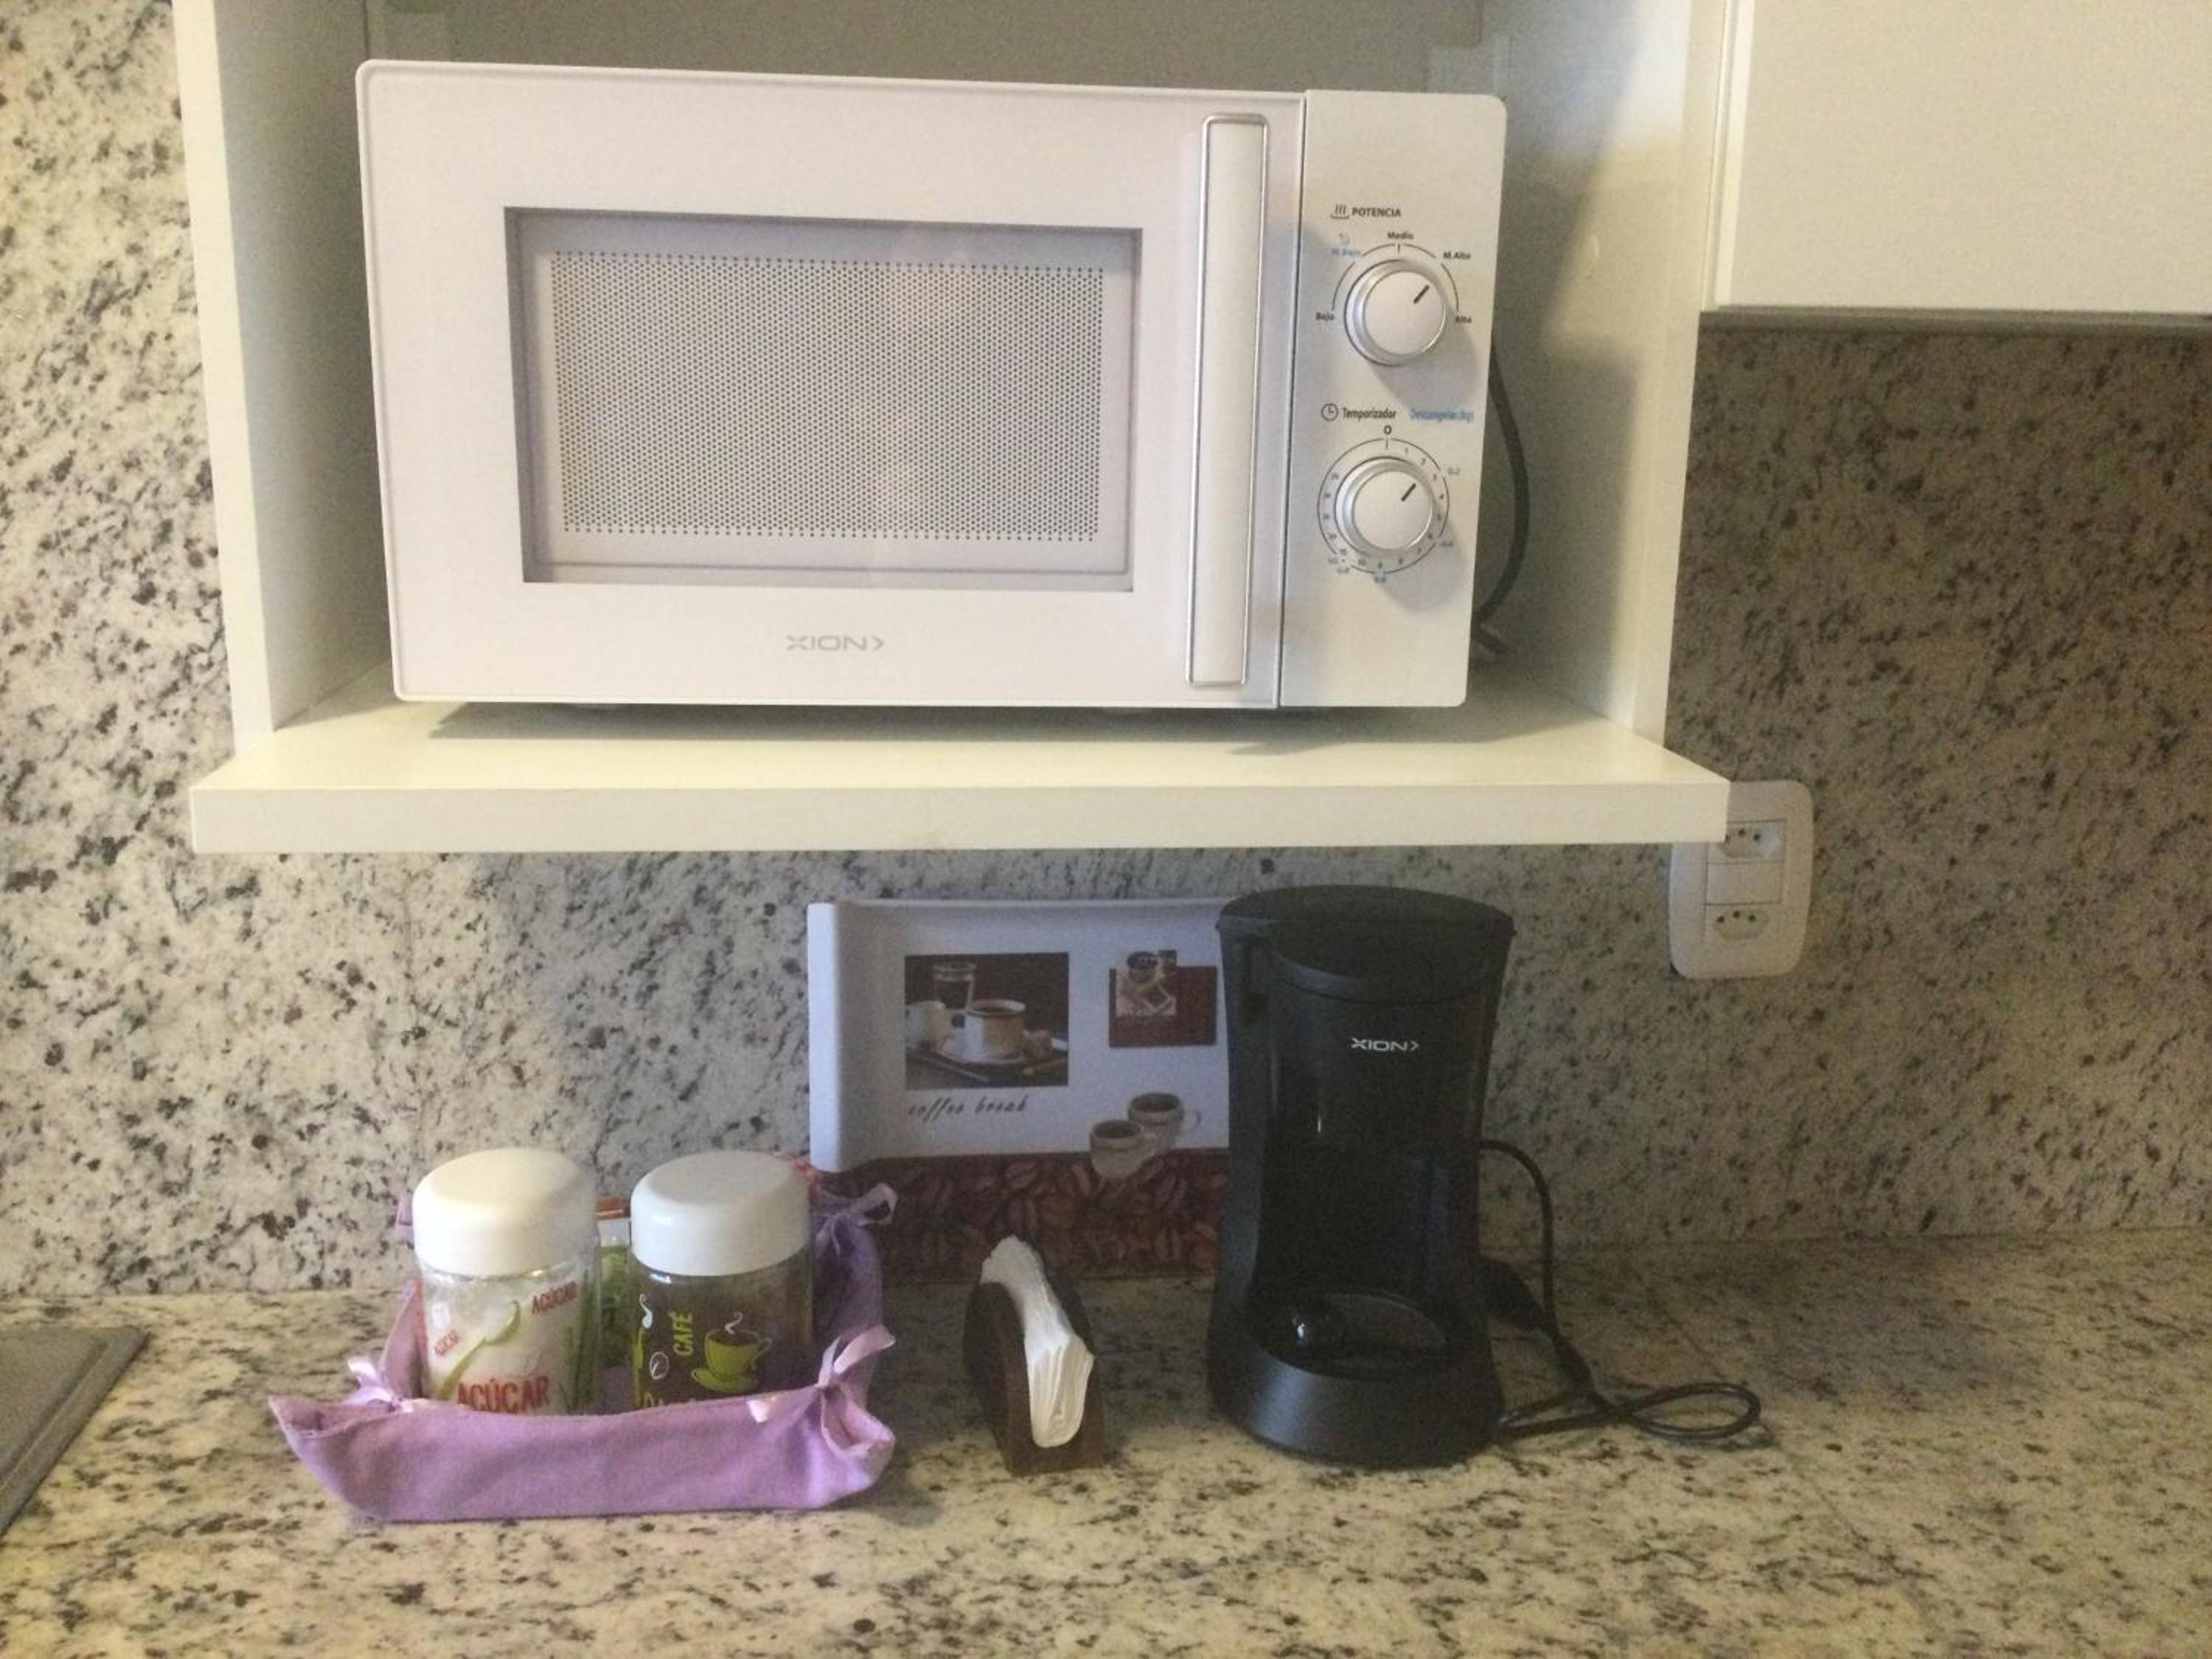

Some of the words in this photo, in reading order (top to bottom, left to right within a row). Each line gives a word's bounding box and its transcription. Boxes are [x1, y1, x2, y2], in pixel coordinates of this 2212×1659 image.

[1352, 207, 1401, 218] POTENCIA
[1343, 407, 1397, 420] Temporizador
[908, 1096, 964, 1122] coffee
